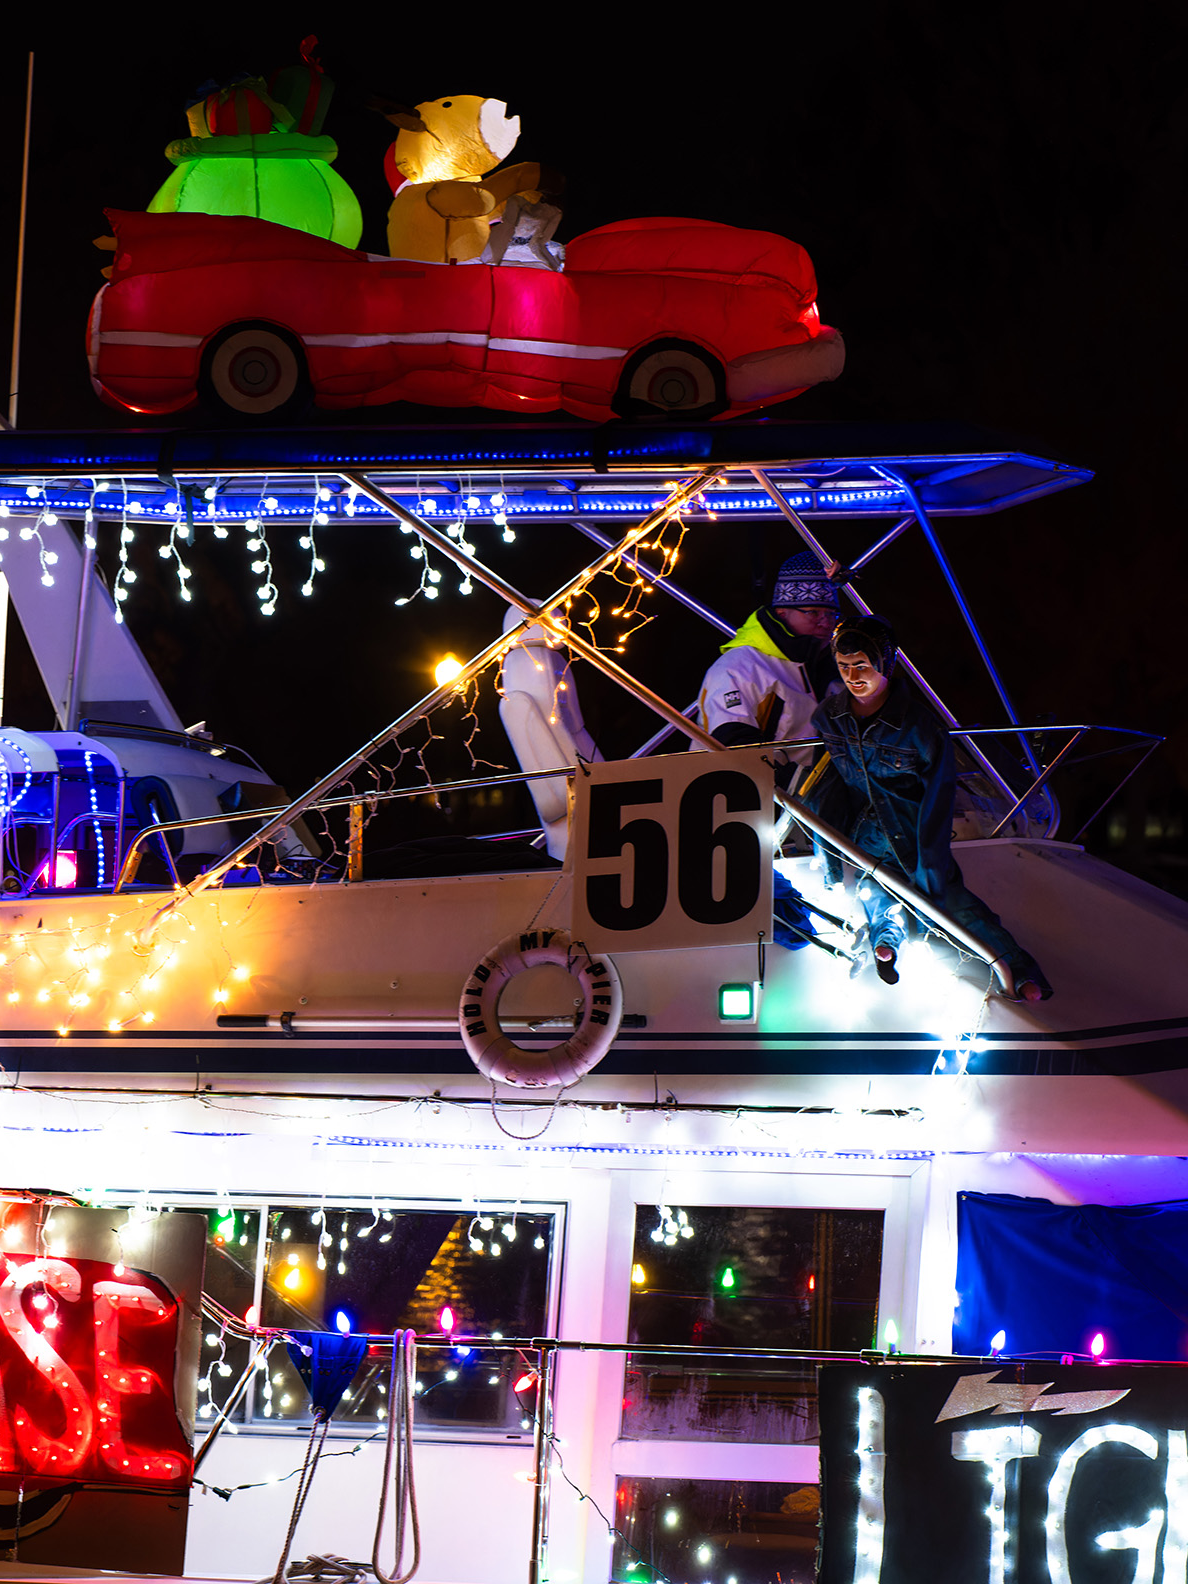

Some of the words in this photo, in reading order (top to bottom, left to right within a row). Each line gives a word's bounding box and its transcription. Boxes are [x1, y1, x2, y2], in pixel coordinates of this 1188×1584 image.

[585, 769, 762, 932] 56
[463, 964, 492, 1038] HOLD
[520, 931, 556, 953] MY
[584, 961, 612, 1026] PIER
